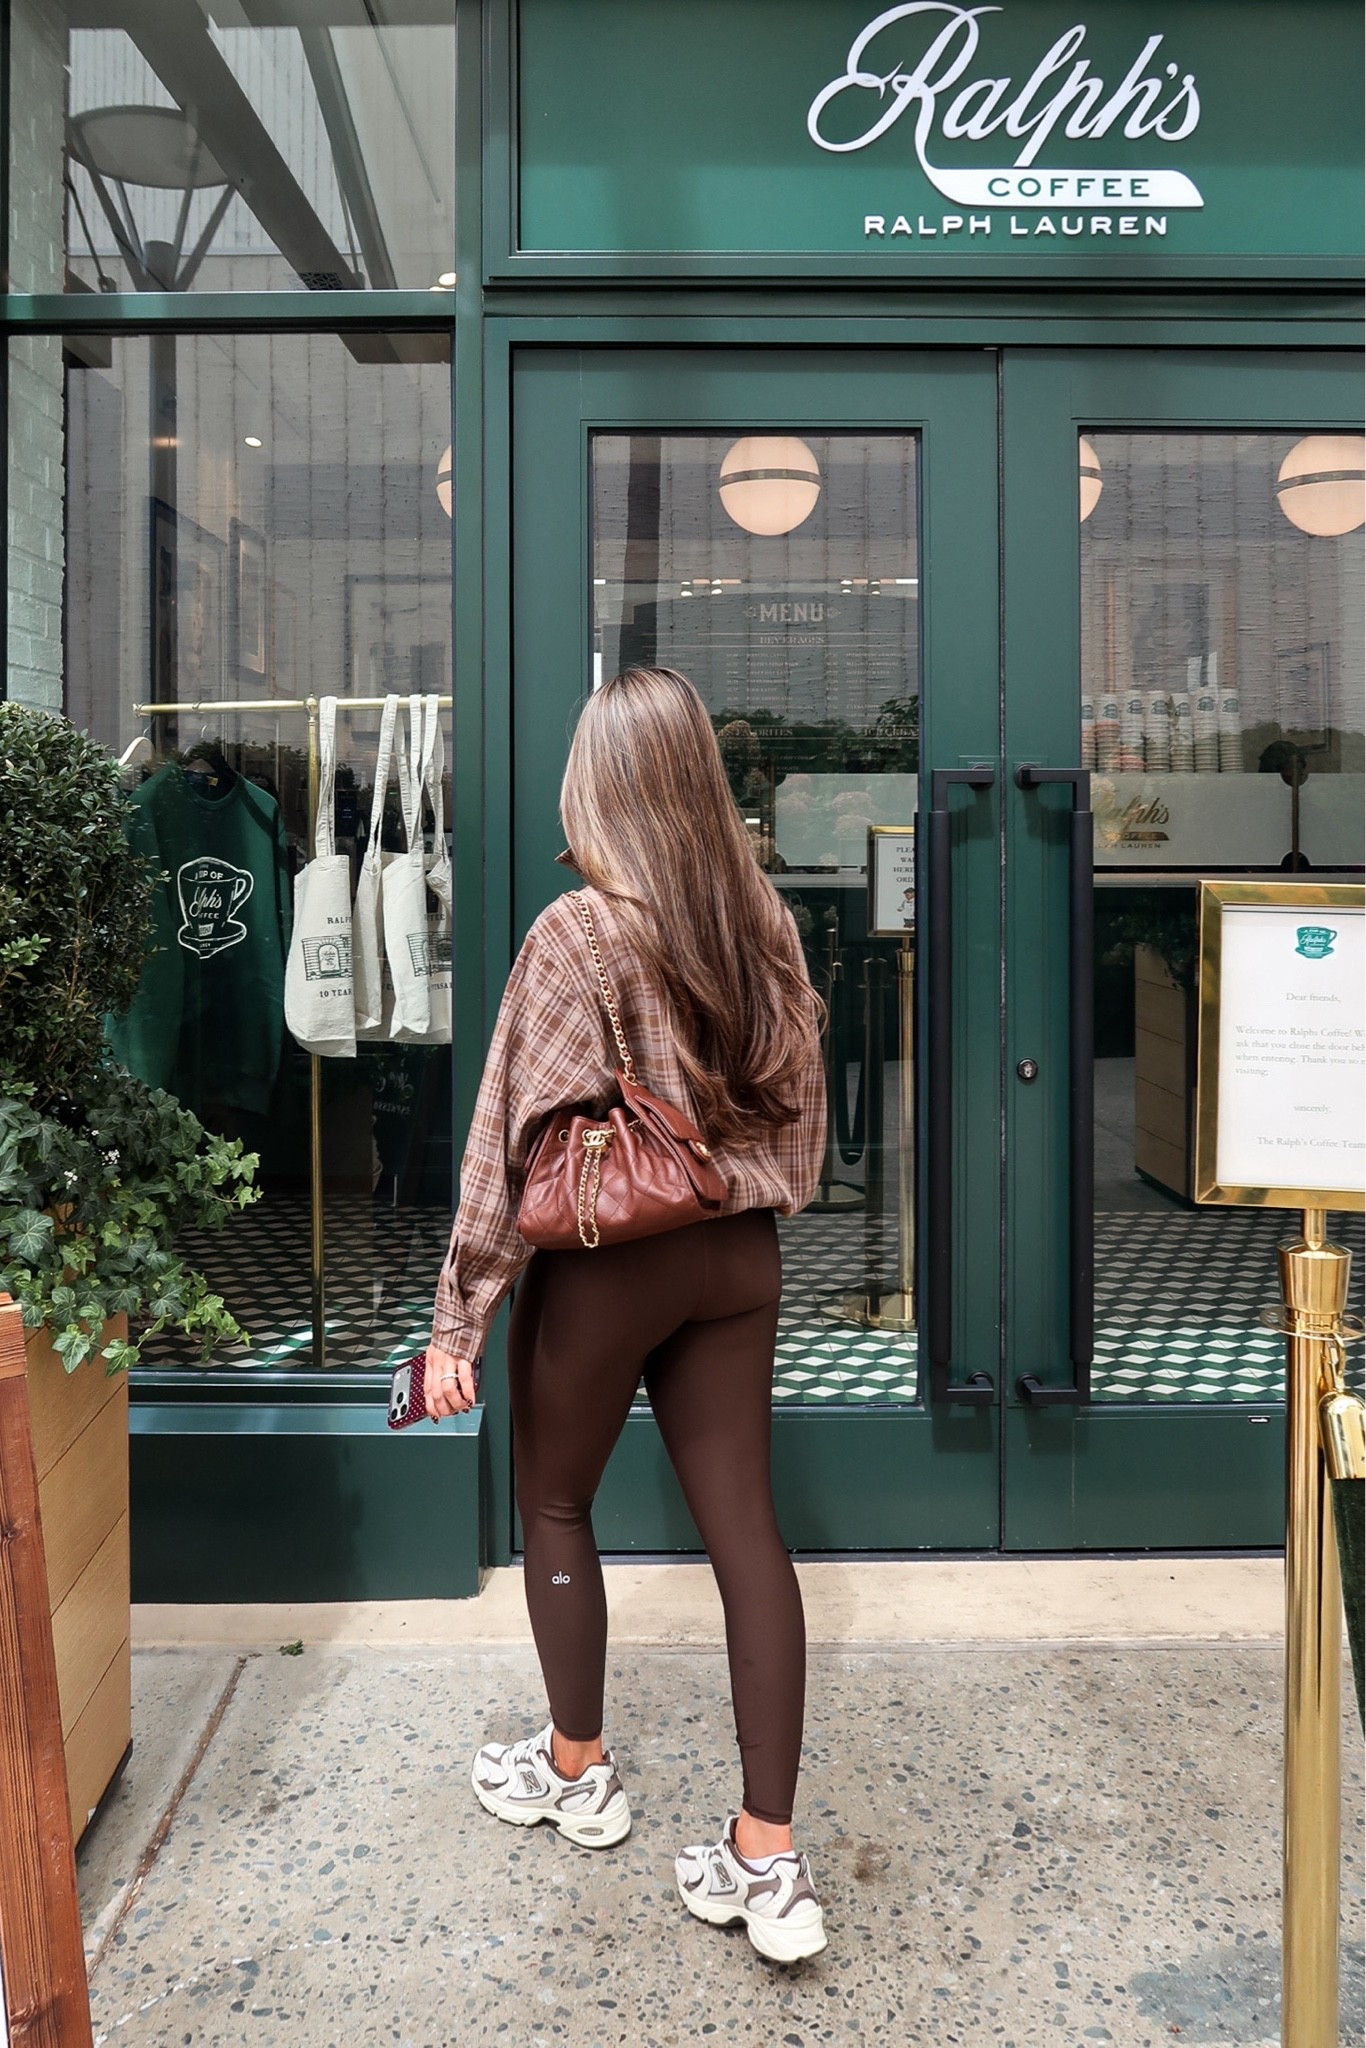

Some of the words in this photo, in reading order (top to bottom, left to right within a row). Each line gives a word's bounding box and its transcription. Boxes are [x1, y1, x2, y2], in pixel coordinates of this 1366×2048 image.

[807, 1, 1203, 168] Ralph's
[987, 178, 1151, 198] COFFEE
[864, 215, 991, 236] RALPH
[1010, 215, 1168, 236] LAUREN
[760, 603, 824, 622] MENU
[760, 636, 825, 644] BEVERAGES
[209, 871, 224, 880] OF
[319, 990, 329, 998] 10
[1286, 992, 1307, 1001] Dear
[1309, 992, 1341, 1004] friends,
[1236, 1025, 1276, 1035] Welcome
[1236, 1040, 1248, 1048] ask
[1252, 1040, 1268, 1048] that
[1270, 1041, 1286, 1051] you
[1288, 1041, 1310, 1050] close
[1312, 1042, 1326, 1050] the
[1328, 1043, 1349, 1051] door
[1235, 1052, 1259, 1061] when
[1301, 1055, 1327, 1064] Thank
[1330, 1058, 1345, 1066] you
[1257, 1136, 1273, 1145] The
[1310, 1138, 1338, 1148] Coffee
[551, 1570, 571, 1585] alo
